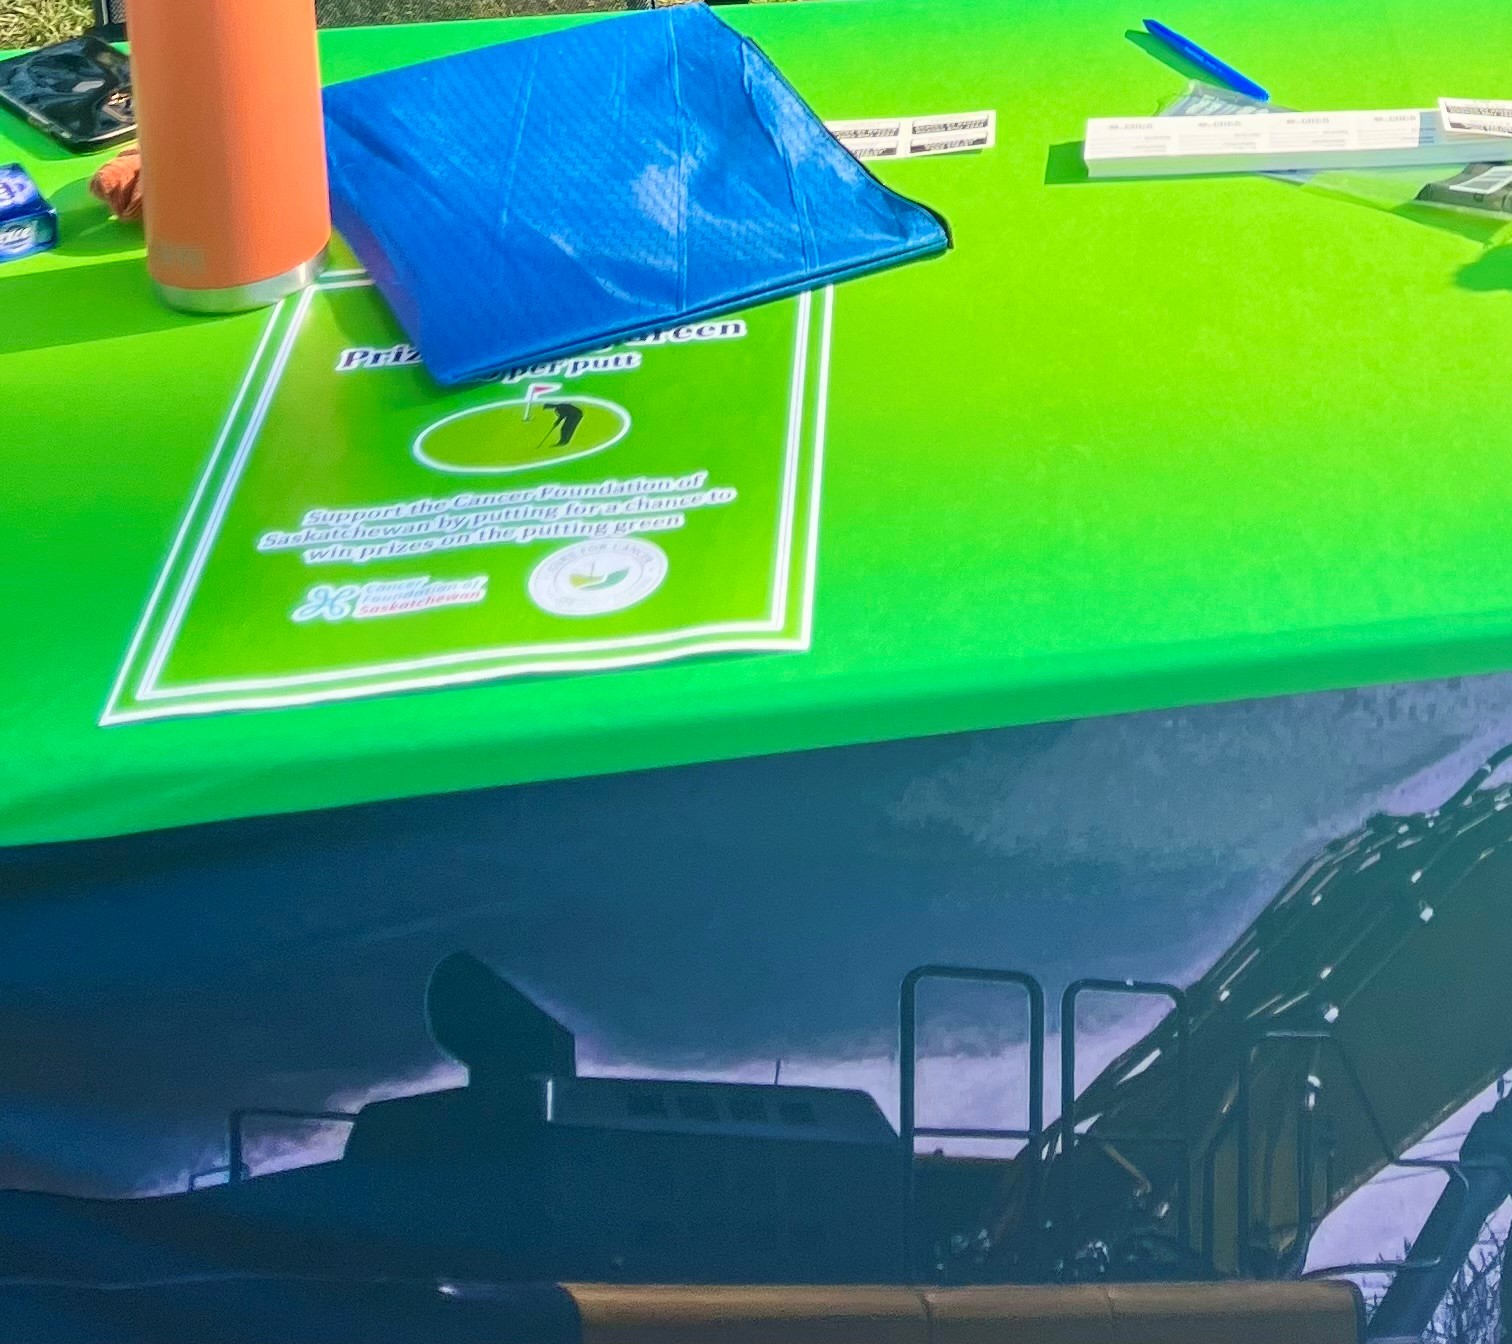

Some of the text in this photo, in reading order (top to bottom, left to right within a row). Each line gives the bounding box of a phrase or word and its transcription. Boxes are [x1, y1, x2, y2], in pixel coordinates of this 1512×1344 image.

[342, 345, 421, 369] Priz
[569, 353, 635, 375] putt
[263, 516, 431, 548] Saskatchewan
[438, 514, 467, 532] by
[472, 504, 558, 527] putting
[565, 501, 596, 516] for
[624, 495, 703, 512] chance
[710, 489, 734, 502] to
[307, 472, 706, 525] Support the Cancer Foundation of
[308, 516, 681, 562] win prizes on the putting green
